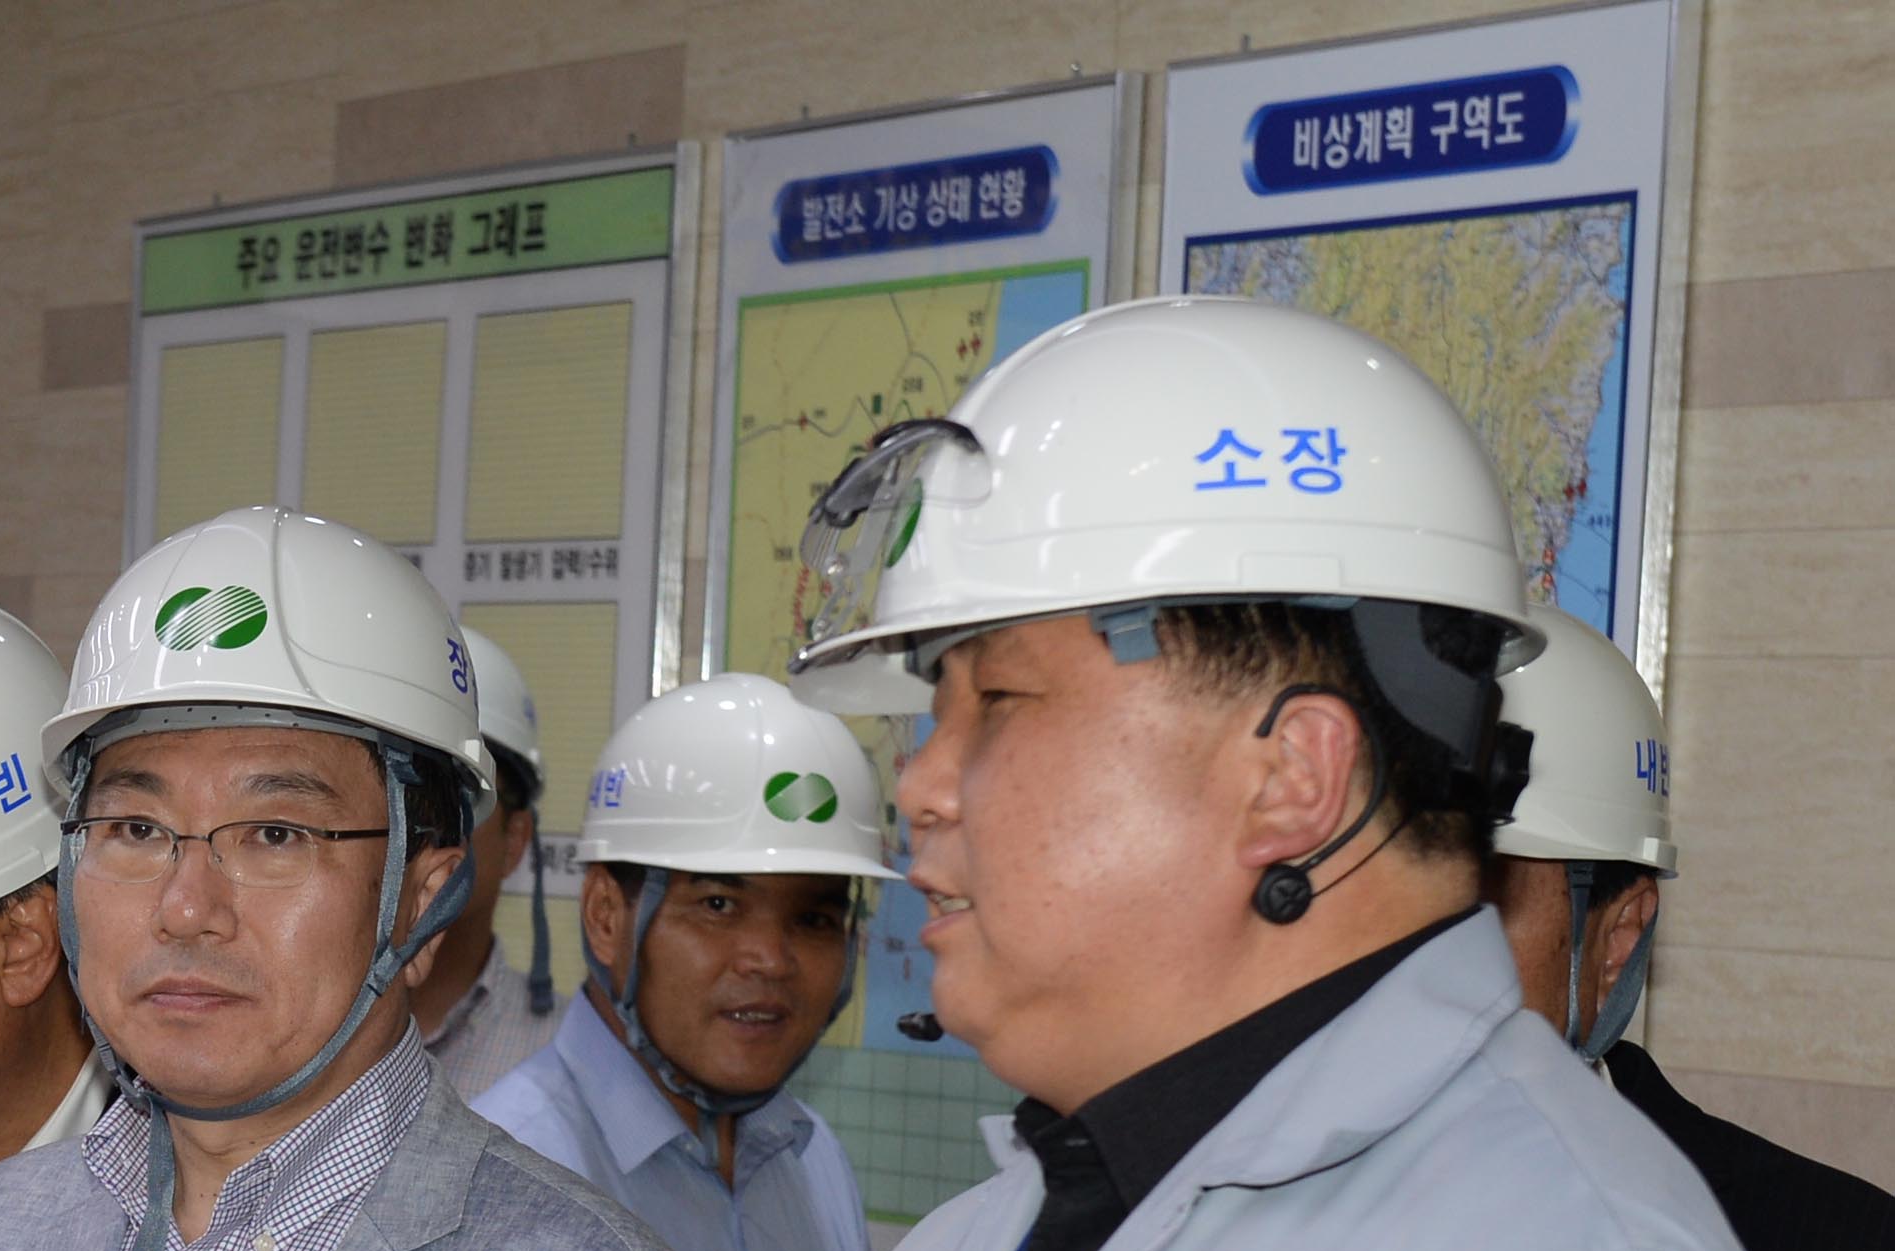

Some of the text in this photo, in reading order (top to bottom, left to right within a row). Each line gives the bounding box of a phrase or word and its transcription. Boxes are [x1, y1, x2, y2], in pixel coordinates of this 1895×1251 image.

[1293, 91, 1525, 171] 비상계획 구역도
[802, 167, 1027, 243] 발전소 기상 상태 현황
[237, 201, 547, 289] 주요 운전변수 변화 그래프
[1195, 427, 1347, 494] 소장
